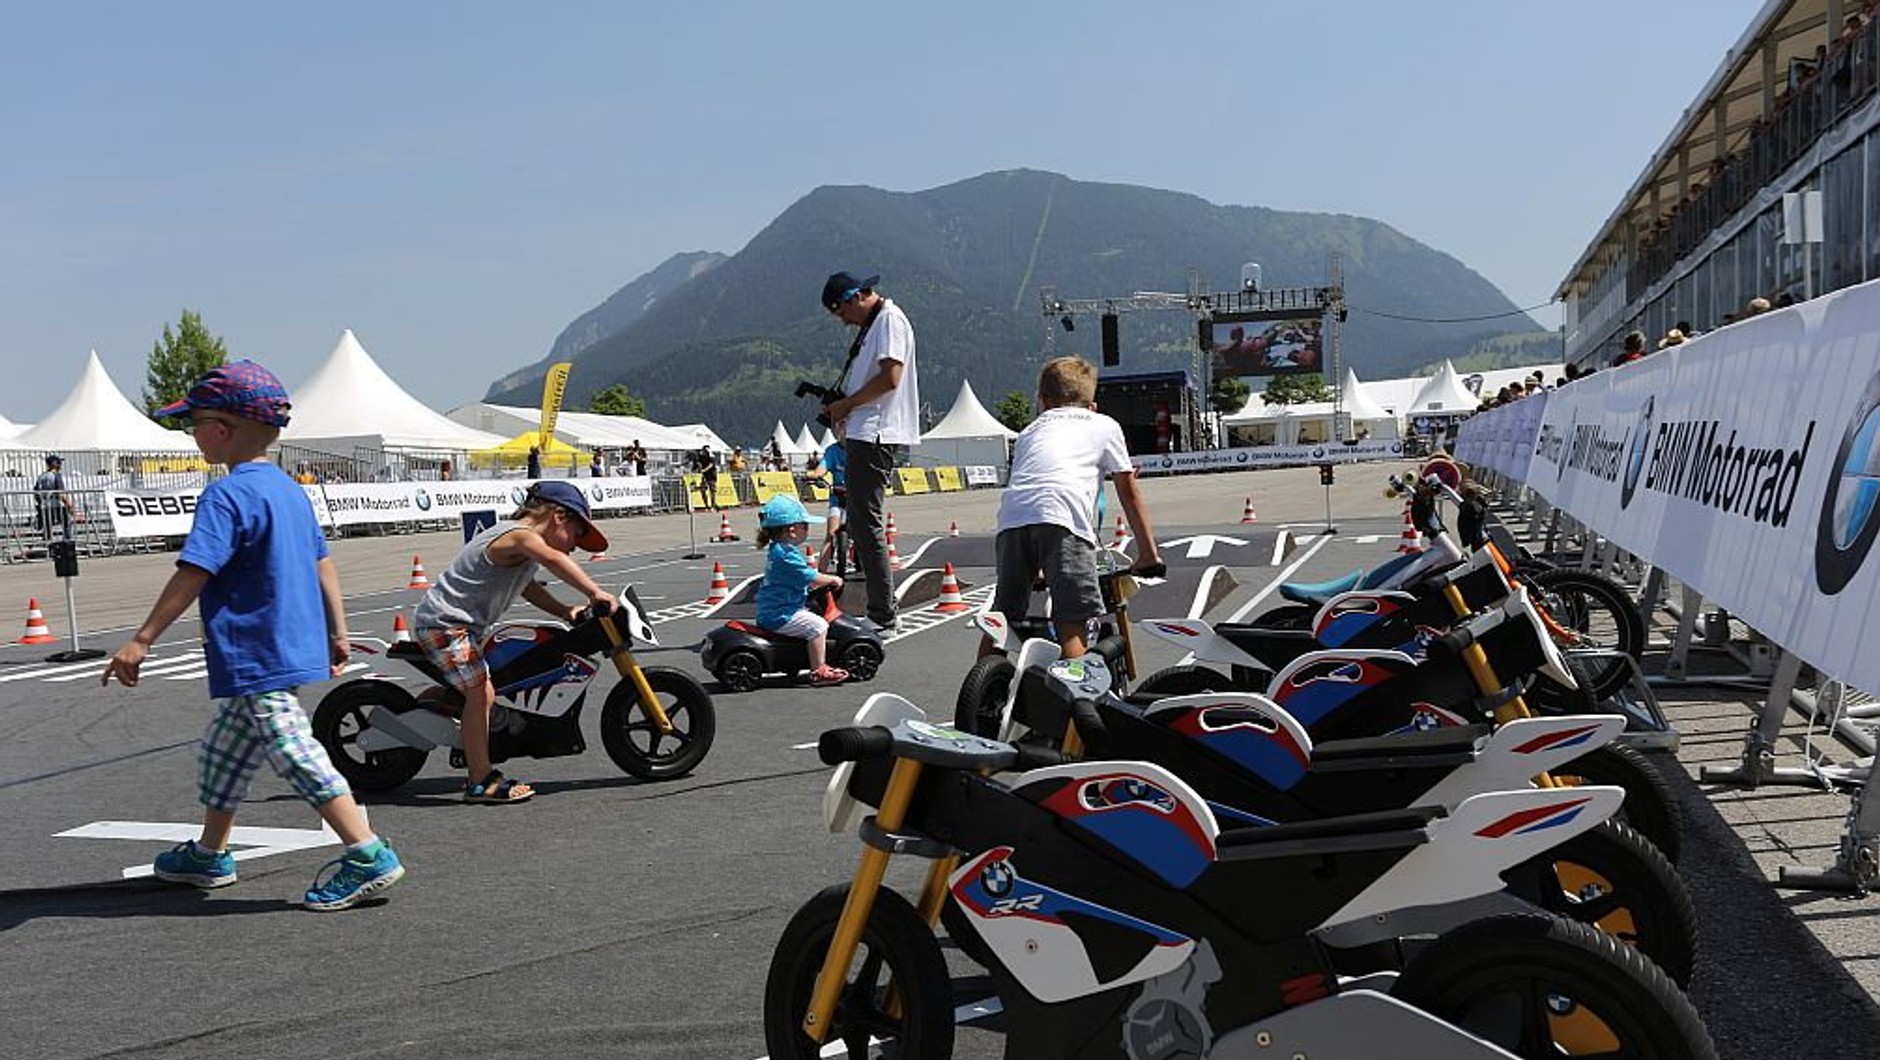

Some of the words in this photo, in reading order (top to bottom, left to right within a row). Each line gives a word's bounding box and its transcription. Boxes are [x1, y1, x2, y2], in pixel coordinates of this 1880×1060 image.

[1646, 421, 1699, 496] BMW
[1685, 420, 1816, 528] Motorrad
[114, 495, 200, 516] SIEBE
[327, 498, 358, 511] BMW
[361, 495, 410, 510] Motorrad
[436, 493, 463, 506] BMW
[463, 492, 506, 504] Motorrad
[989, 894, 1043, 914] RR
